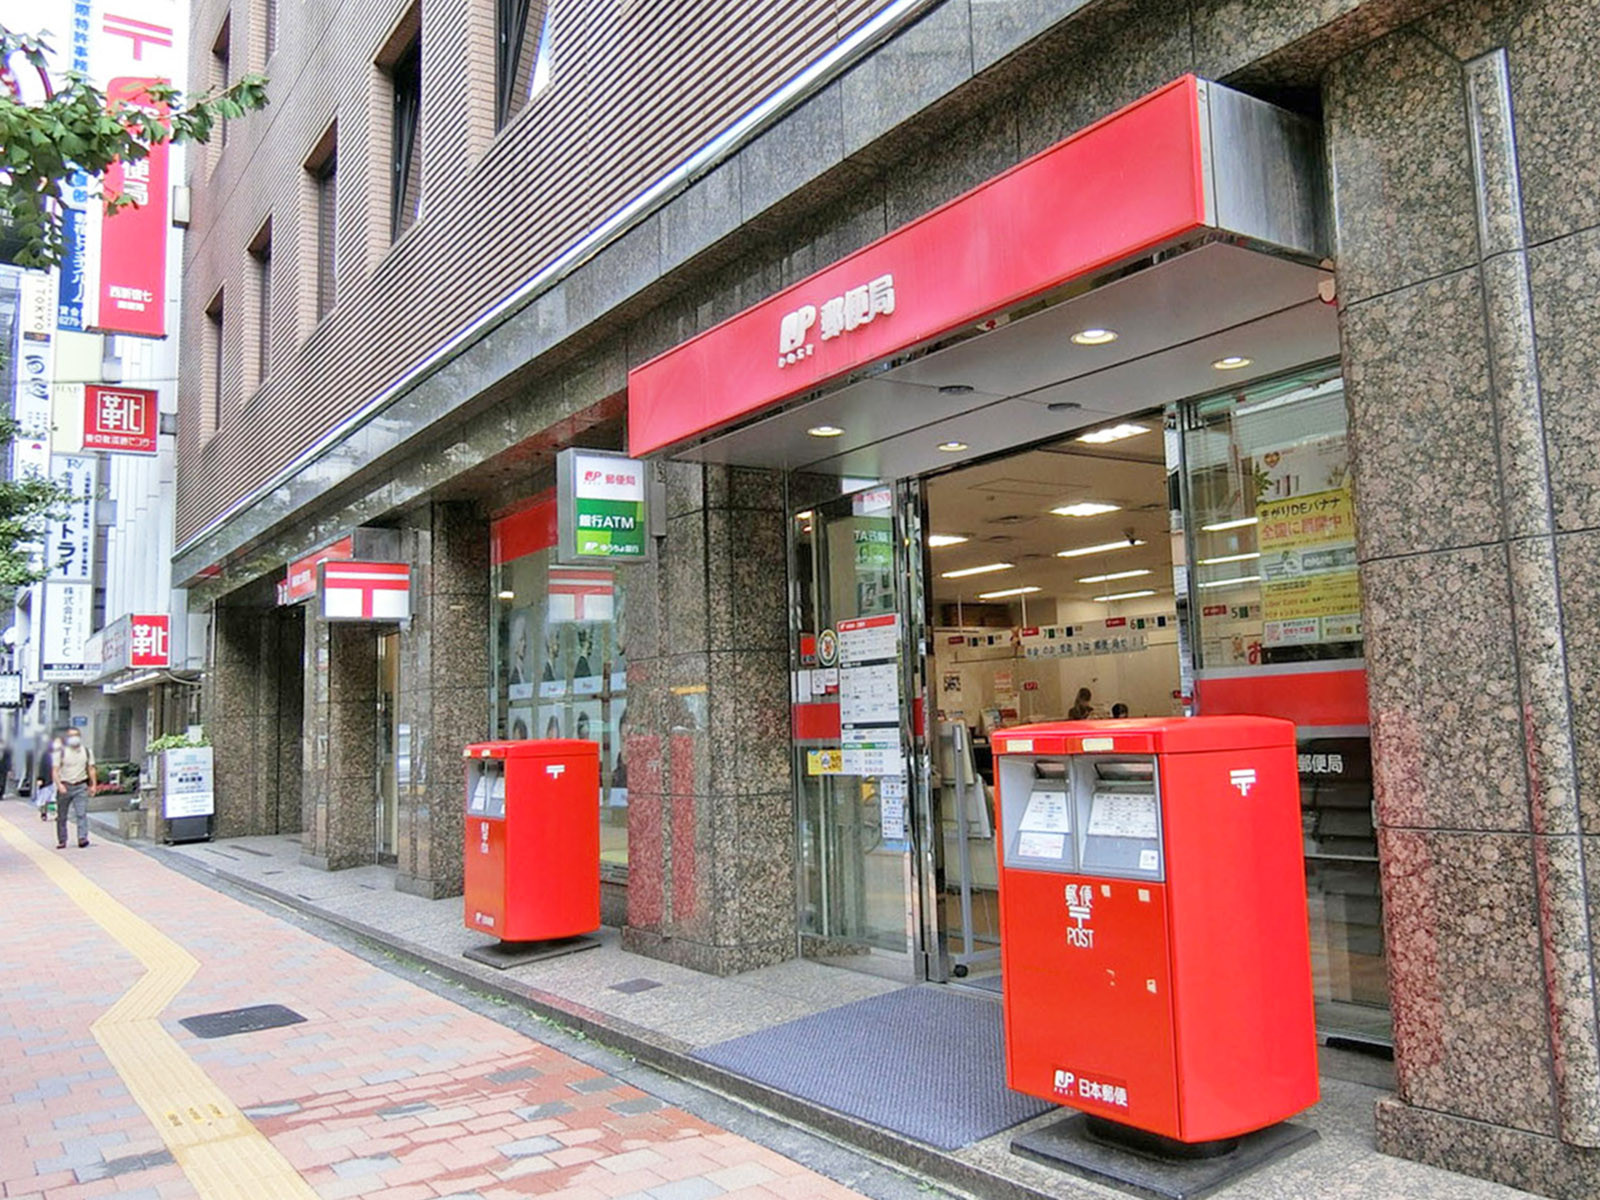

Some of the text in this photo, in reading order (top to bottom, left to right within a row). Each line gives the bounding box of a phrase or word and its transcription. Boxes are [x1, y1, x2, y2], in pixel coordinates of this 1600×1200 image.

[780, 274, 895, 354] JP 郵便局
[778, 344, 814, 368] POST
[102, 395, 140, 431] 靴
[605, 474, 636, 486] 郵便局
[579, 514, 634, 529] 銀行ATM
[600, 543, 639, 553] ゆうちょ銀行
[1231, 607, 1238, 619] 5
[1130, 619, 1137, 630] 6
[133, 624, 168, 657] 靴
[1297, 754, 1343, 773] 郵便局
[1065, 884, 1093, 908] 郵便
[1066, 927, 1094, 948] POST
[1054, 1069, 1128, 1107] JP 日本郵便
